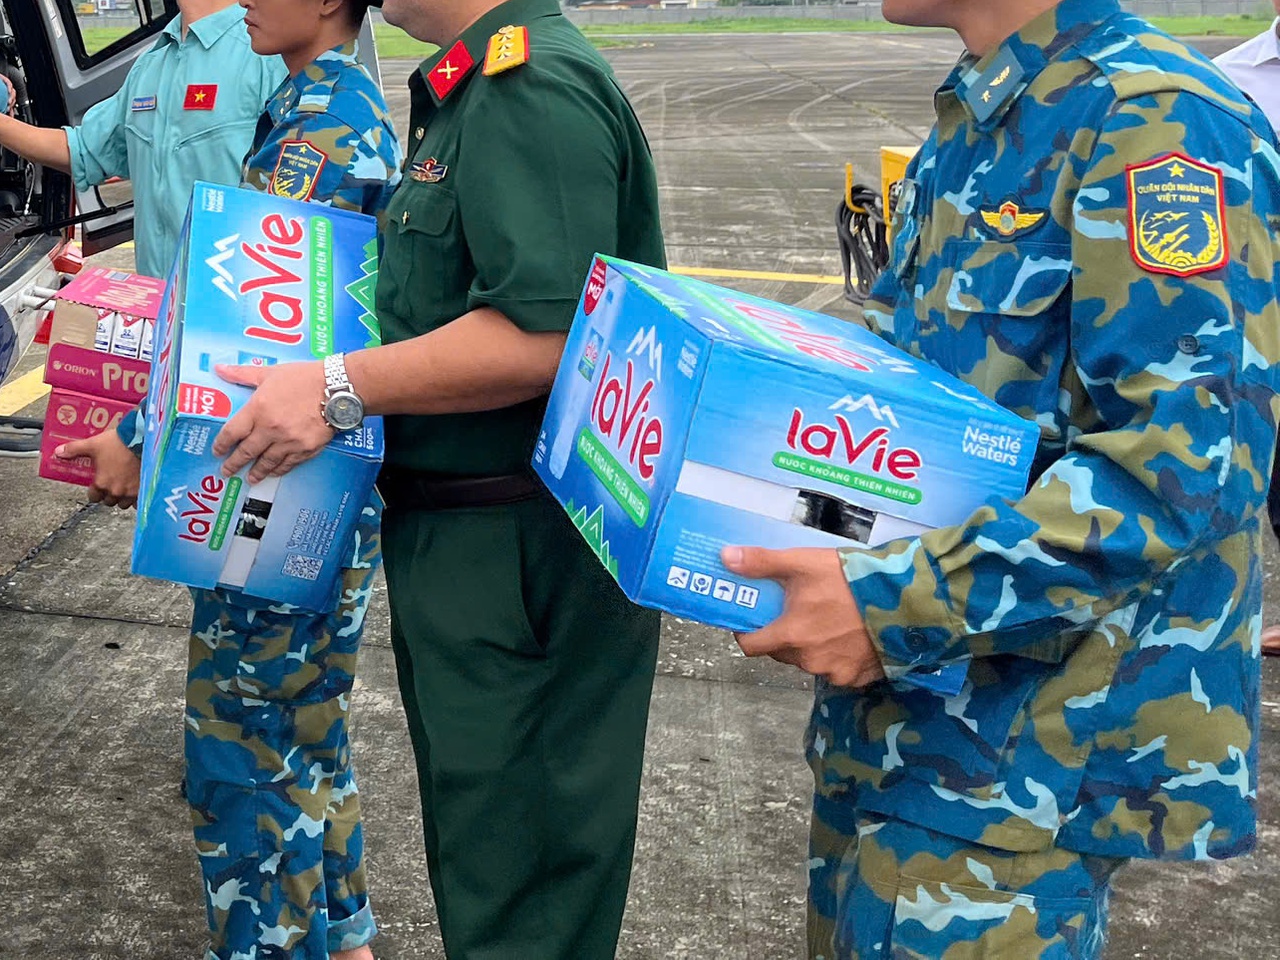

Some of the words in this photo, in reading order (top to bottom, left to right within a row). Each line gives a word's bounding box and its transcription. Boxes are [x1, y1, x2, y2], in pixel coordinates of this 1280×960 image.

[1156, 192, 1178, 204] VIỆT
[1179, 194, 1200, 204] NAM
[315, 220, 326, 248] NHIÊN
[63, 363, 96, 377] ORION
[344, 434, 353, 447] 24
[964, 425, 1022, 454] Nestlé
[962, 440, 1018, 467] Waters
